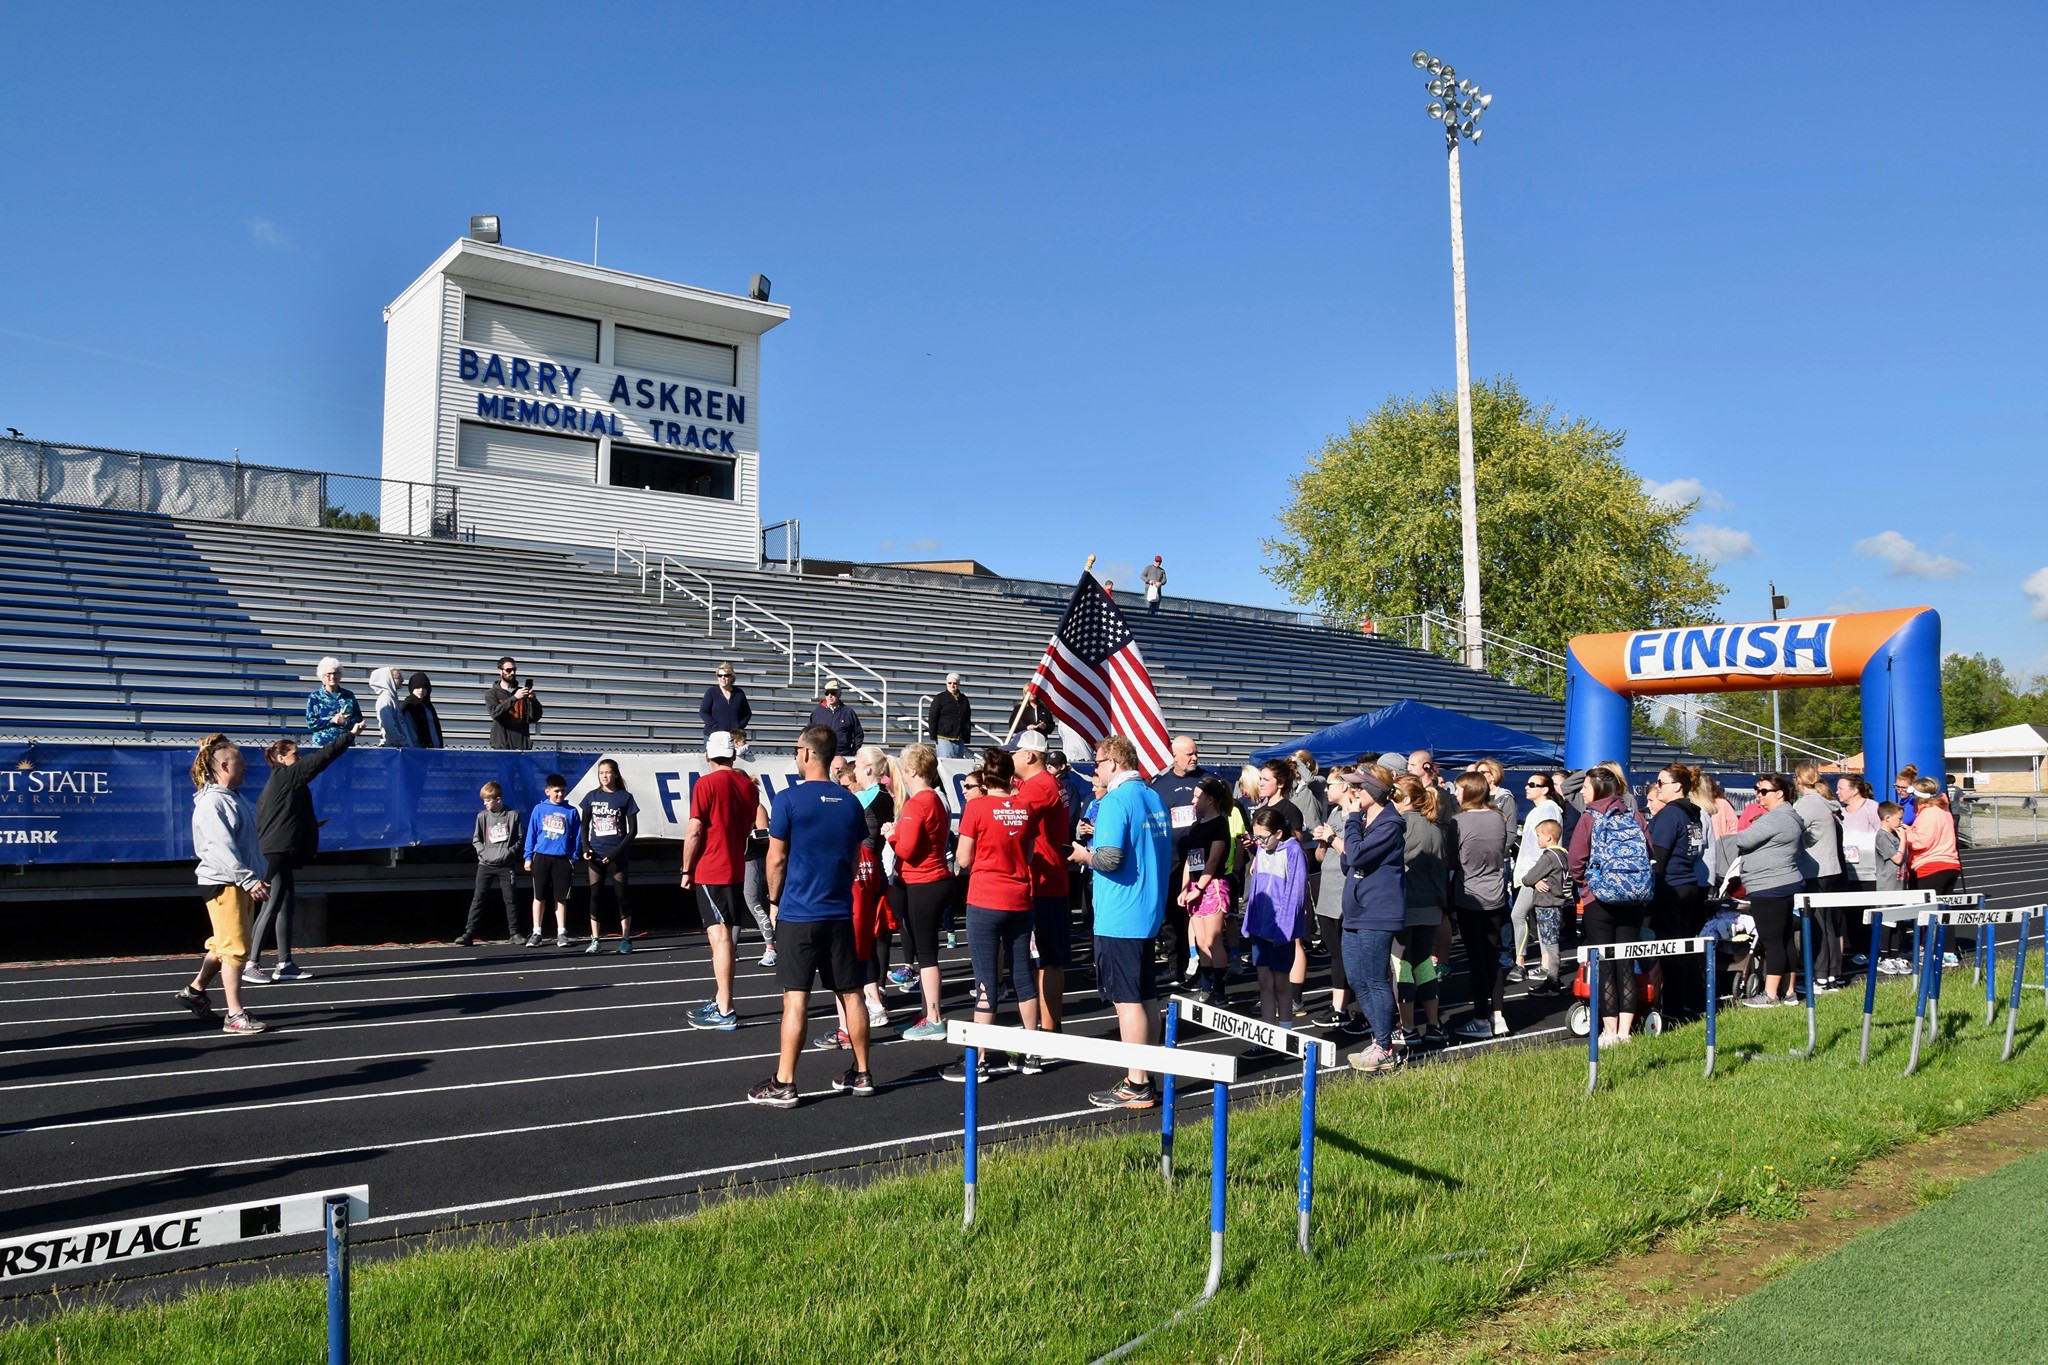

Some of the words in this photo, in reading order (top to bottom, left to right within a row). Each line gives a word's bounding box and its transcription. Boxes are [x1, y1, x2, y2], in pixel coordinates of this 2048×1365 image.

[458, 348, 581, 396] BARRY
[609, 374, 745, 424] ASKREN
[477, 393, 623, 437] MEMORIAL
[649, 419, 735, 453] TRACK
[1629, 622, 1831, 675] FINISH
[0, 830, 58, 844] TARK
[1624, 944, 1648, 957] FIRST
[1650, 942, 1677, 956] PLACE
[1212, 1011, 1239, 1034] FIRST
[1240, 1021, 1275, 1047] PLACE
[80, 1216, 202, 1264] PLACE
